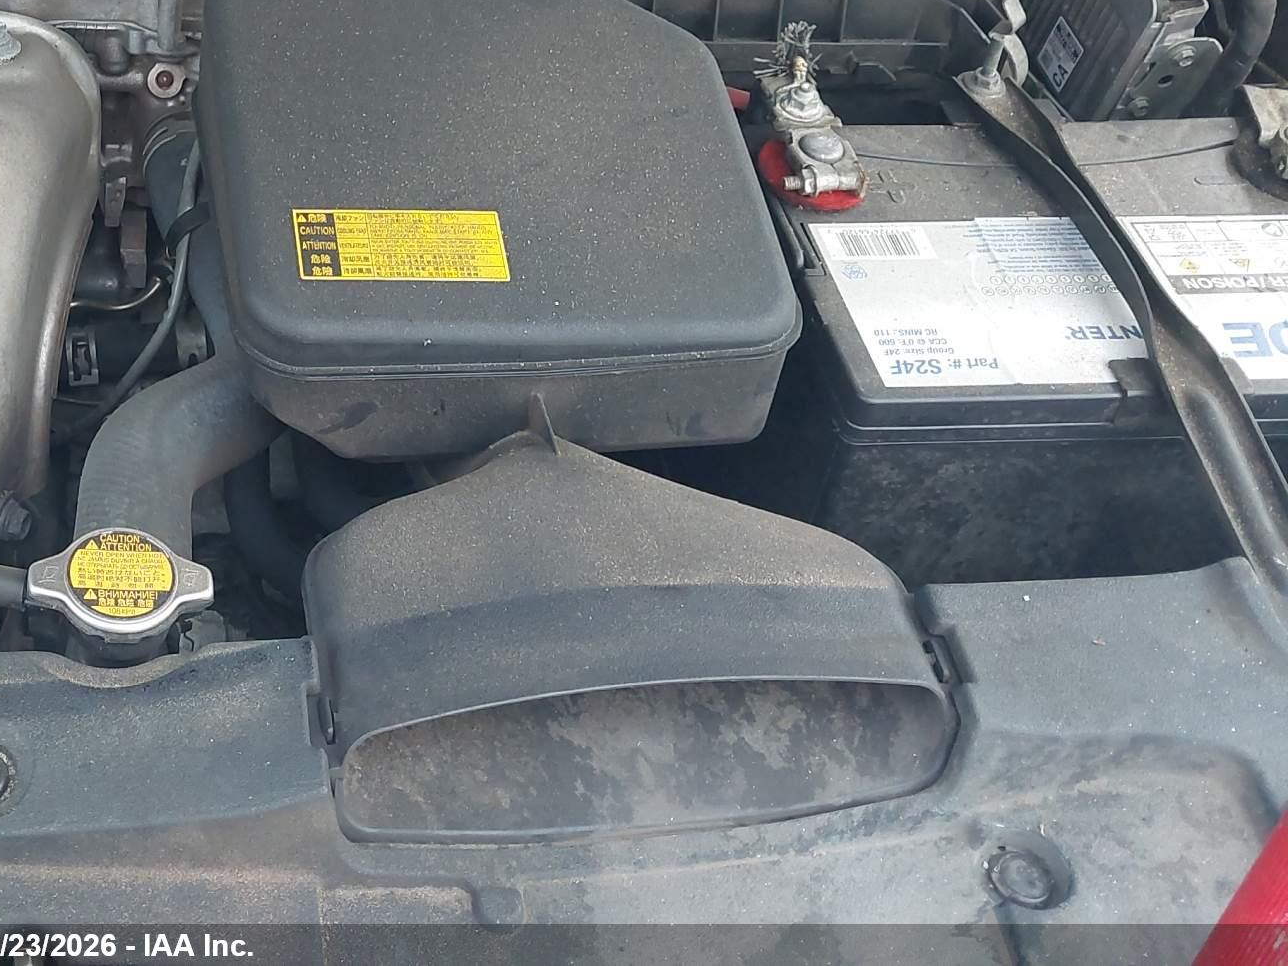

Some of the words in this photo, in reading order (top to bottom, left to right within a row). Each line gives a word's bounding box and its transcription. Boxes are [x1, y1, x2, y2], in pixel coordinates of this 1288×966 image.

[1052, 63, 1069, 87] CA
[300, 226, 335, 235] CAUTION
[302, 241, 337, 250] ATTENTION
[873, 329, 890, 337] 110
[883, 348, 900, 356] 24F
[927, 346, 954, 355] Group
[889, 359, 942, 375] S24F
[966, 357, 999, 370] Part
[99, 534, 140, 543] CAUTION
[100, 542, 152, 551] ATTENTION
[80, 550, 104, 558] NEVER
[98, 589, 158, 600] ВНИМАНИЕ!
